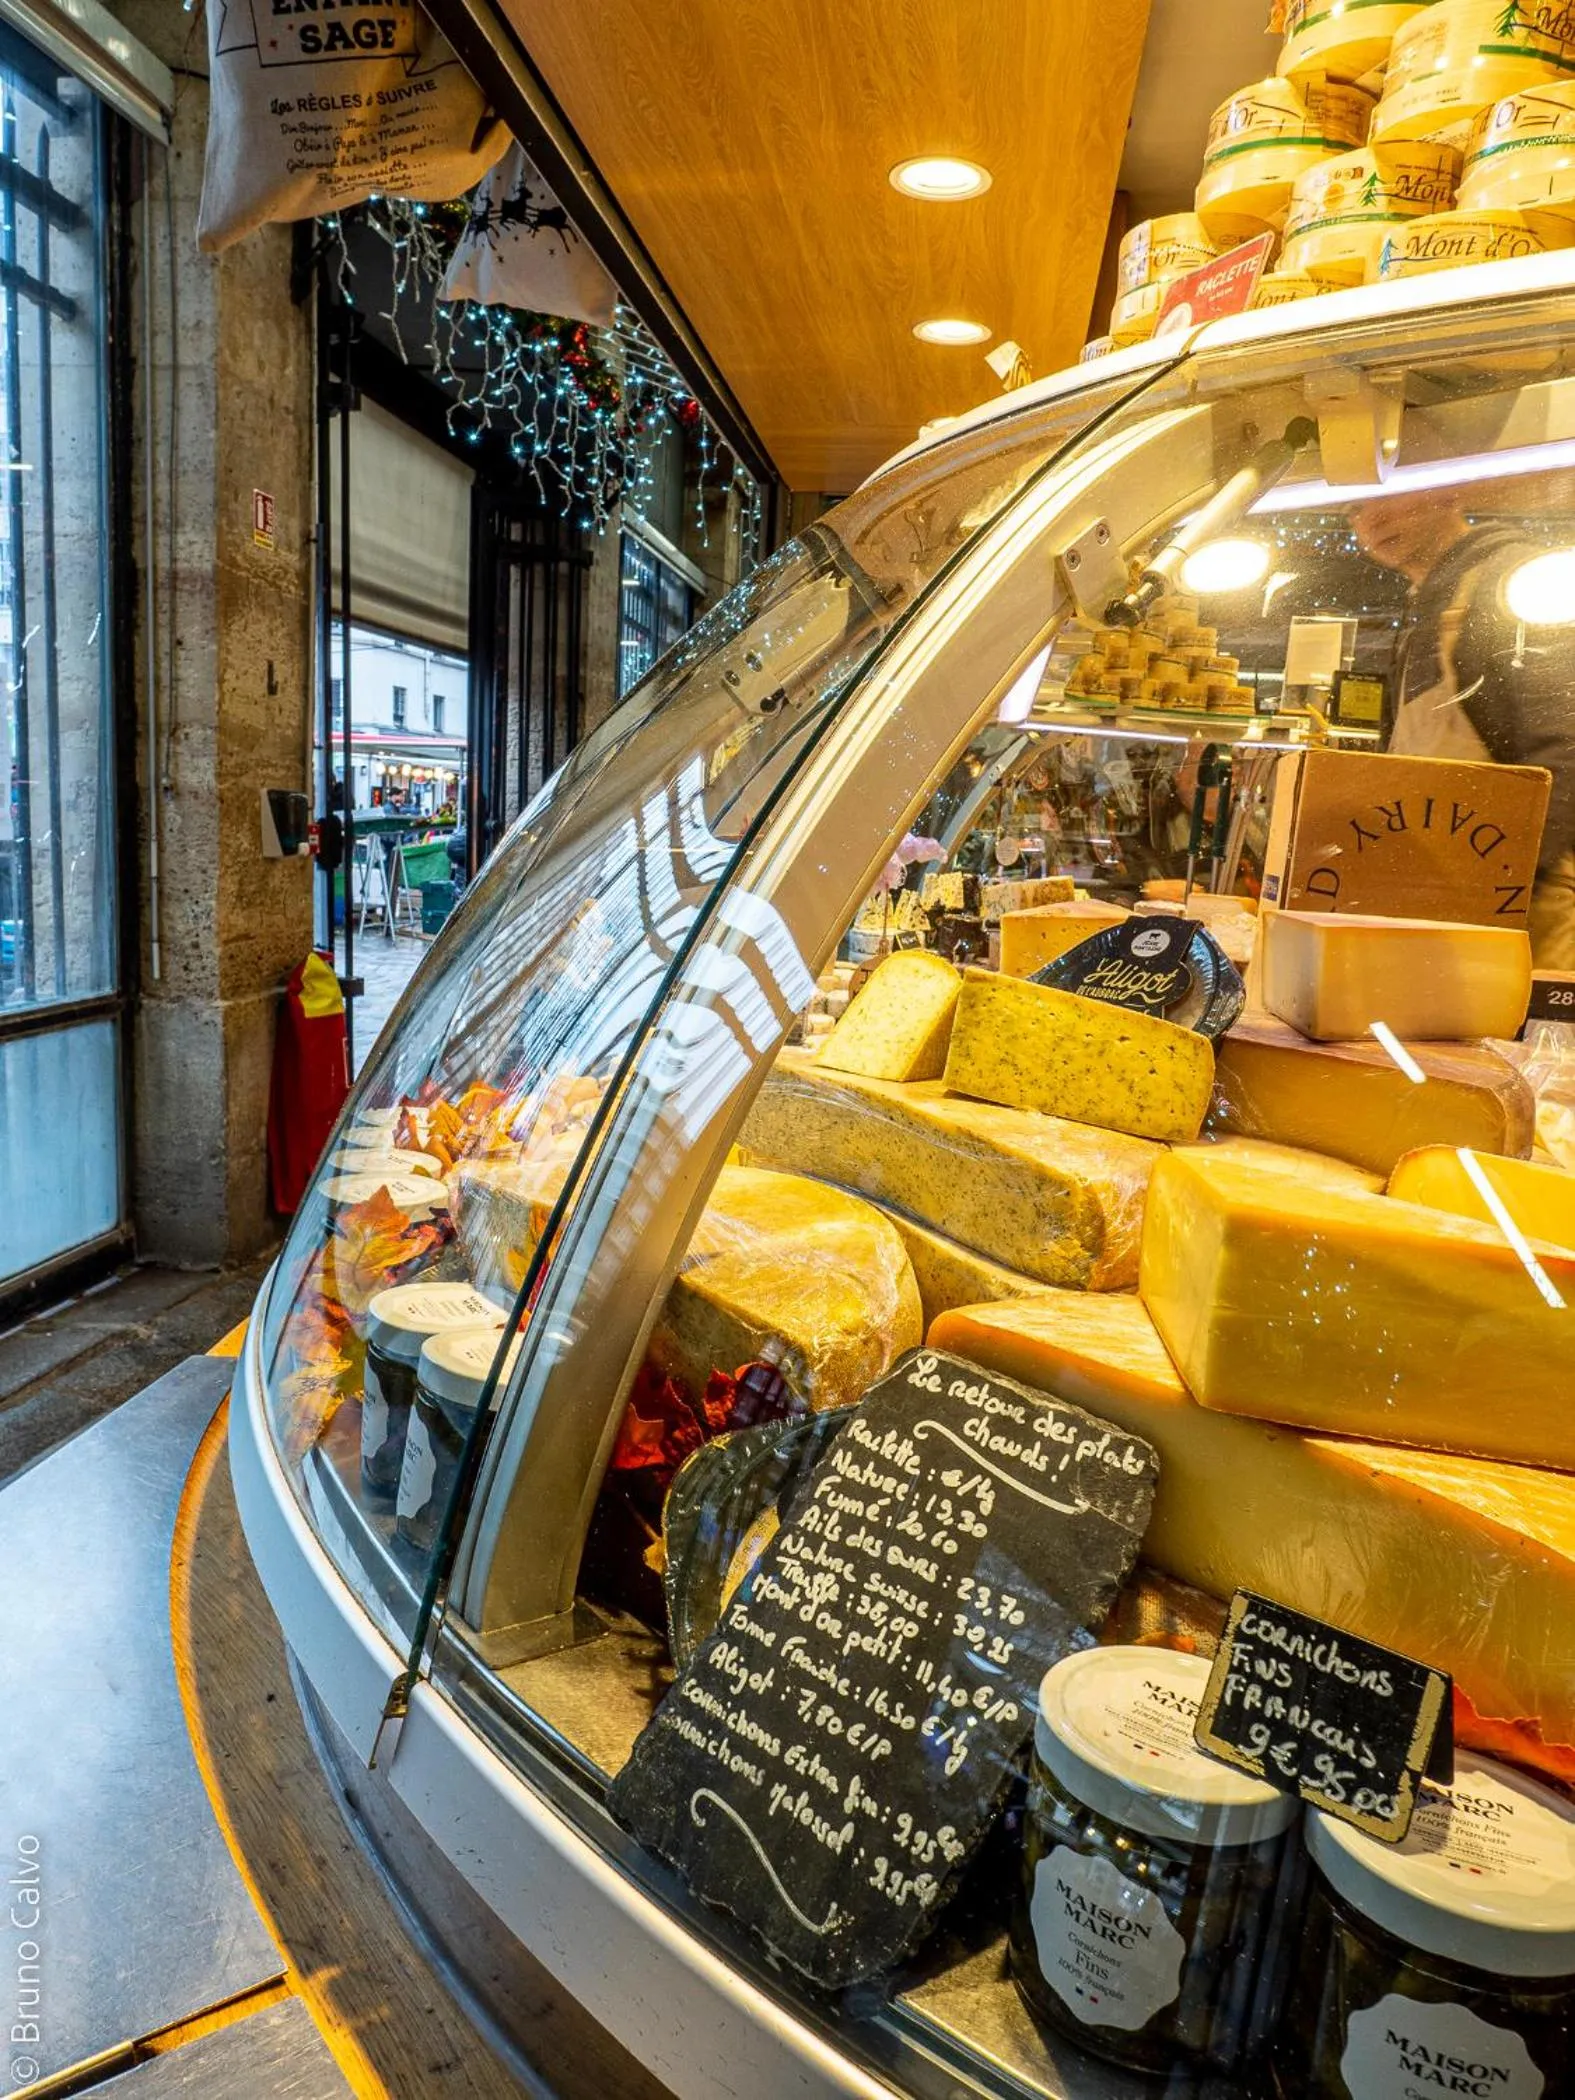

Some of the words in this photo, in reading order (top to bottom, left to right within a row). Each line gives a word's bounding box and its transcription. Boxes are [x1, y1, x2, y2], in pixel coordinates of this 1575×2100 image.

[299, 18, 397, 54] SAGE
[297, 92, 362, 112] RÈGLES
[376, 79, 437, 105] SUIVRE
[1407, 230, 1477, 258] Mont
[1485, 233, 1541, 257] d'O
[1195, 256, 1260, 297] RACLETTE
[1349, 798, 1507, 860] DAIRY
[906, 1356, 942, 1392] Le
[1032, 1410, 1078, 1444] des
[1075, 1433, 1147, 1476] plats
[962, 1416, 1049, 1472] chauds
[845, 1525, 884, 1558] des
[728, 1603, 777, 1649] Tome
[750, 1572, 801, 1611] Mont
[842, 1625, 904, 1665] petit
[708, 1641, 776, 1696] Aligot
[783, 1744, 840, 1795] Extra
[1419, 1808, 1480, 1830] ornichons
[1056, 1878, 1153, 1940] MAISON
[1063, 1901, 1136, 1951] MARC
[1067, 1930, 1122, 1969] Cornichons
[1075, 1948, 1110, 1981] Fins
[1384, 2028, 1512, 2084] MAISON
[1397, 2054, 1493, 2099] MARC
